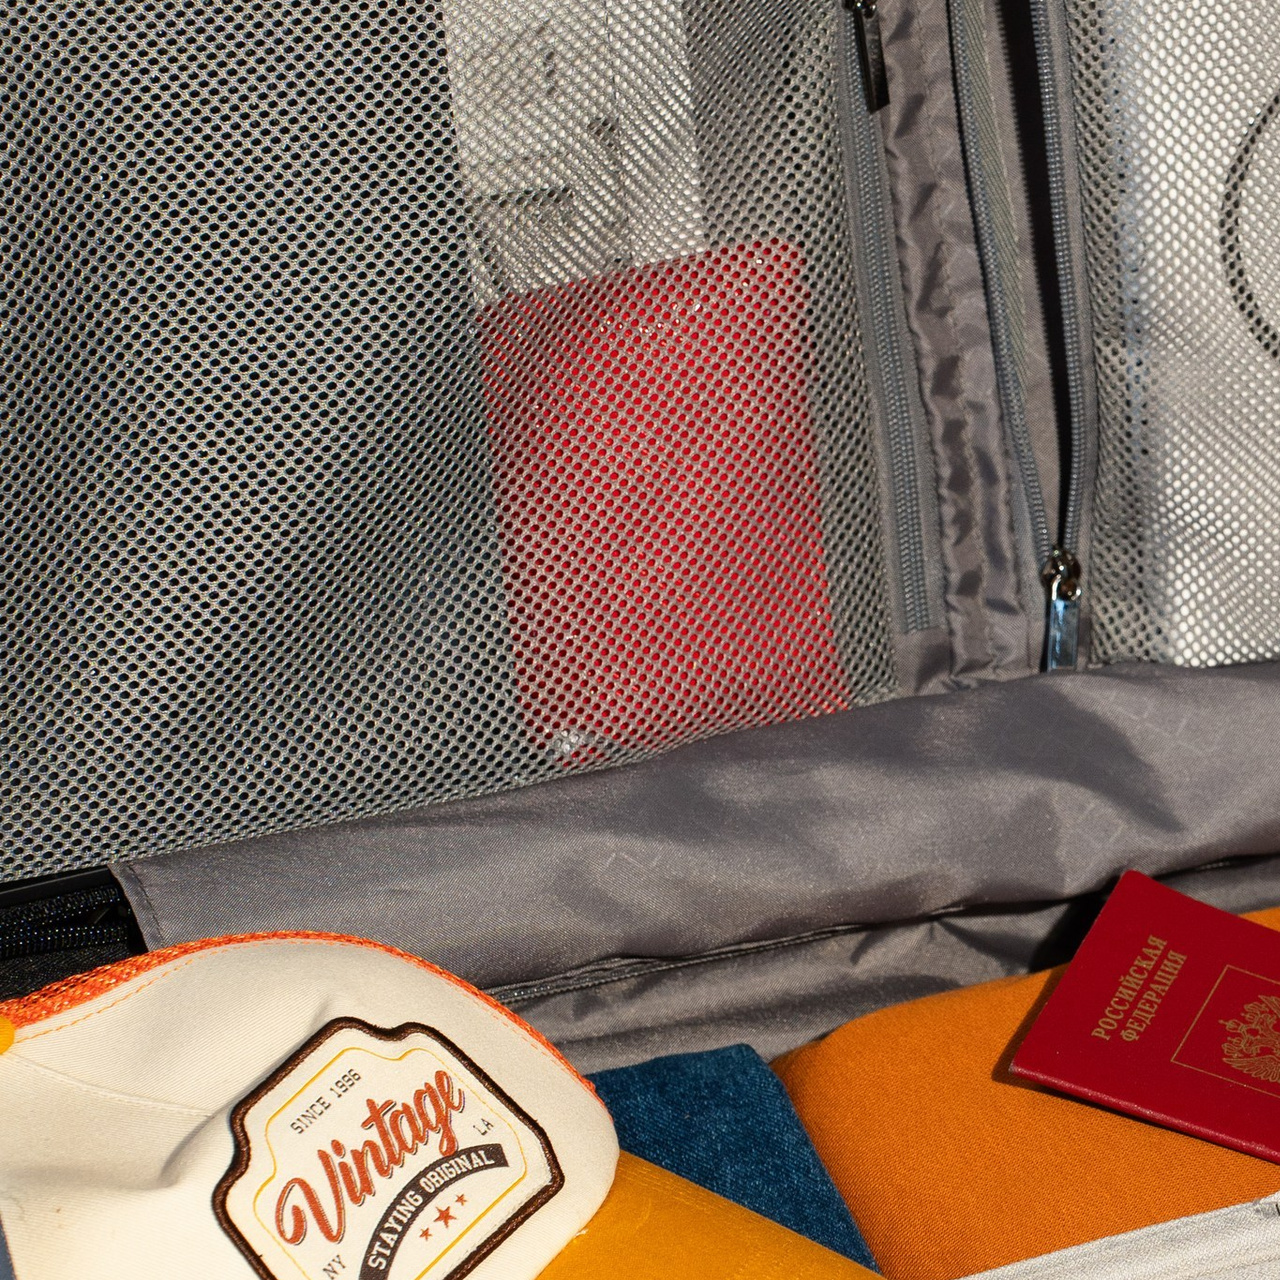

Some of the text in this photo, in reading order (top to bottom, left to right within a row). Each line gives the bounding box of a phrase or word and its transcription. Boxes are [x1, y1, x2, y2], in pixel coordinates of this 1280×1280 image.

[1091, 934, 1168, 1041] РОССИЙСКАЯ
[1120, 950, 1188, 1042] ФЕДЕРАЦИЯ
[289, 1067, 362, 1135] SINCE 1996
[473, 1117, 495, 1137] LA
[274, 1069, 467, 1246] Vintage
[367, 1150, 495, 1271] STAYING ORIGINAL
